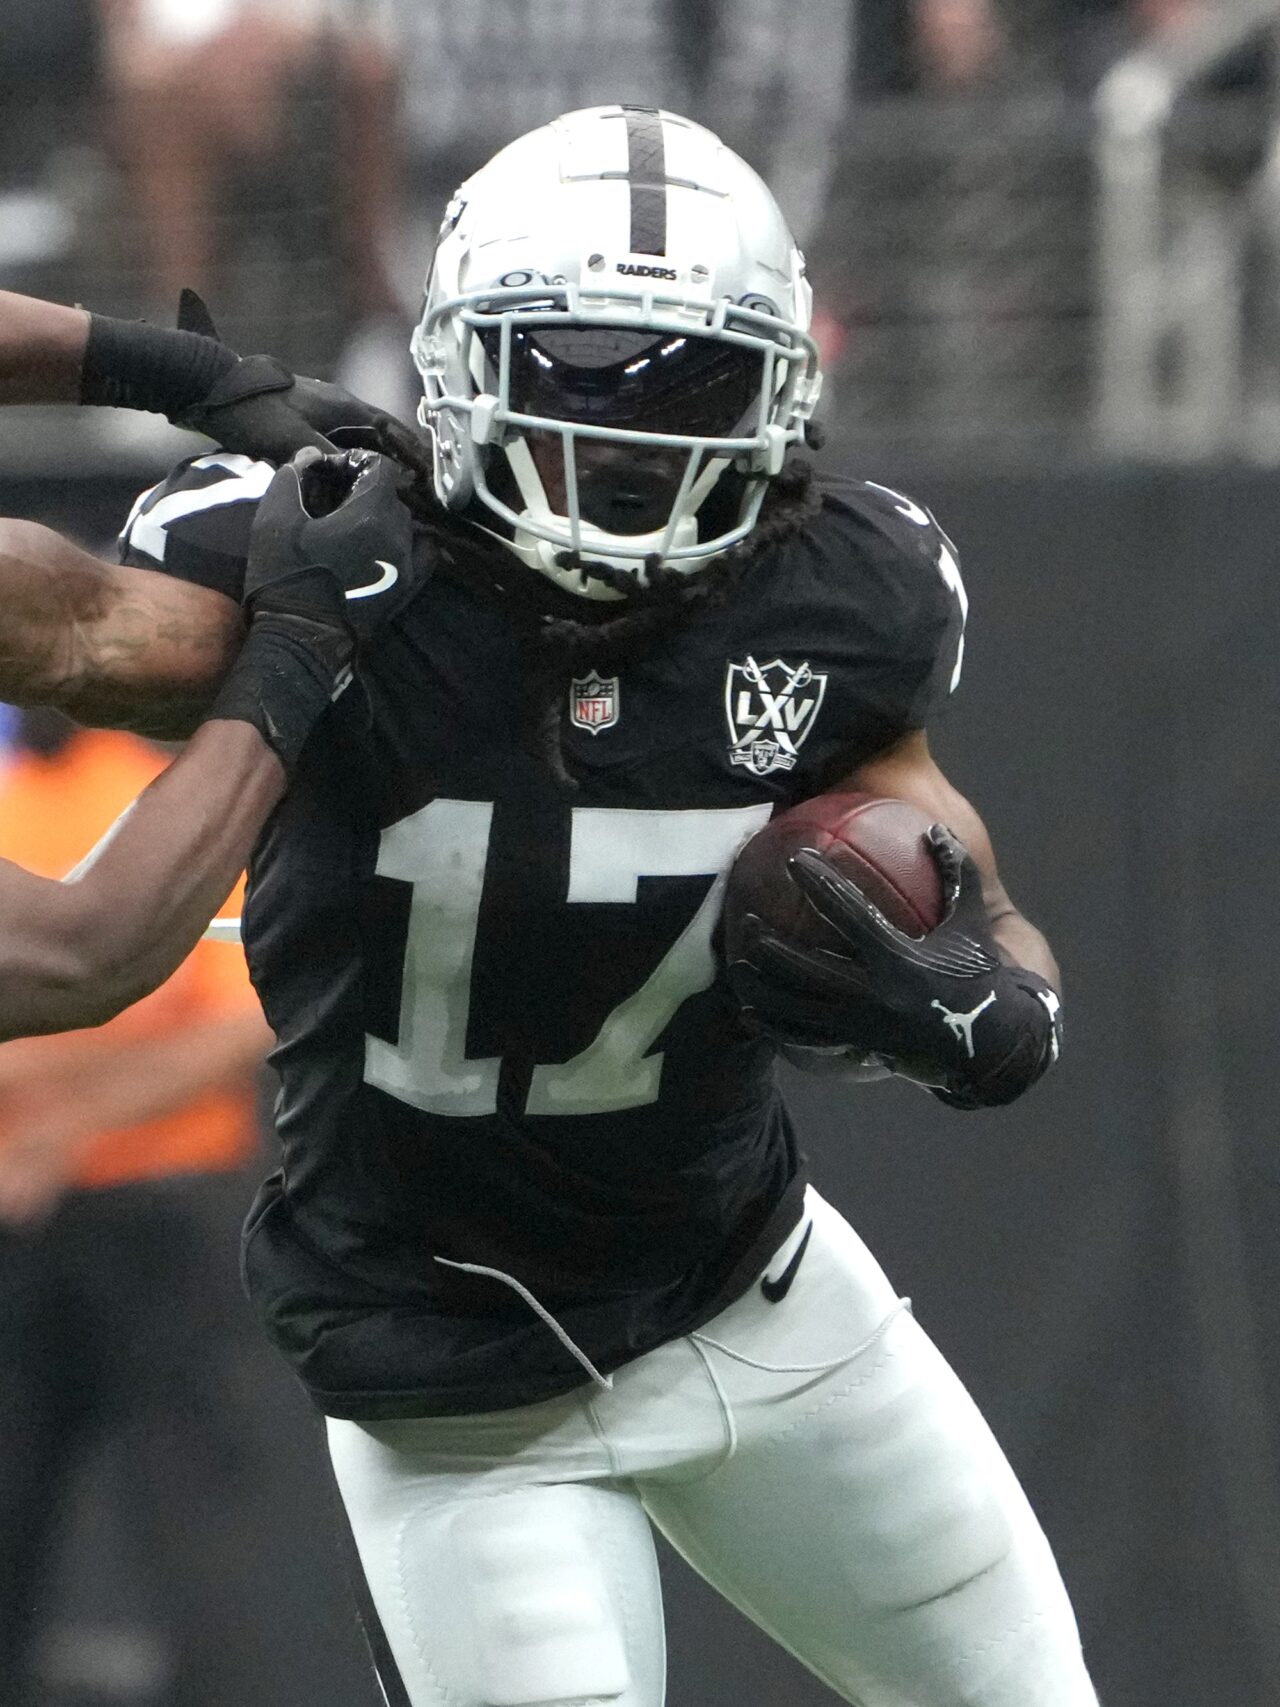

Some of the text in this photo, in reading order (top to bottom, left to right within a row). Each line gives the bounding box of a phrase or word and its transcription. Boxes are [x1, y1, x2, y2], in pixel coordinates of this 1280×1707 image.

[616, 262, 678, 282] RAIDERS
[578, 699, 613, 723] NFL
[735, 691, 815, 731] LXV
[363, 797, 775, 1117] 17
